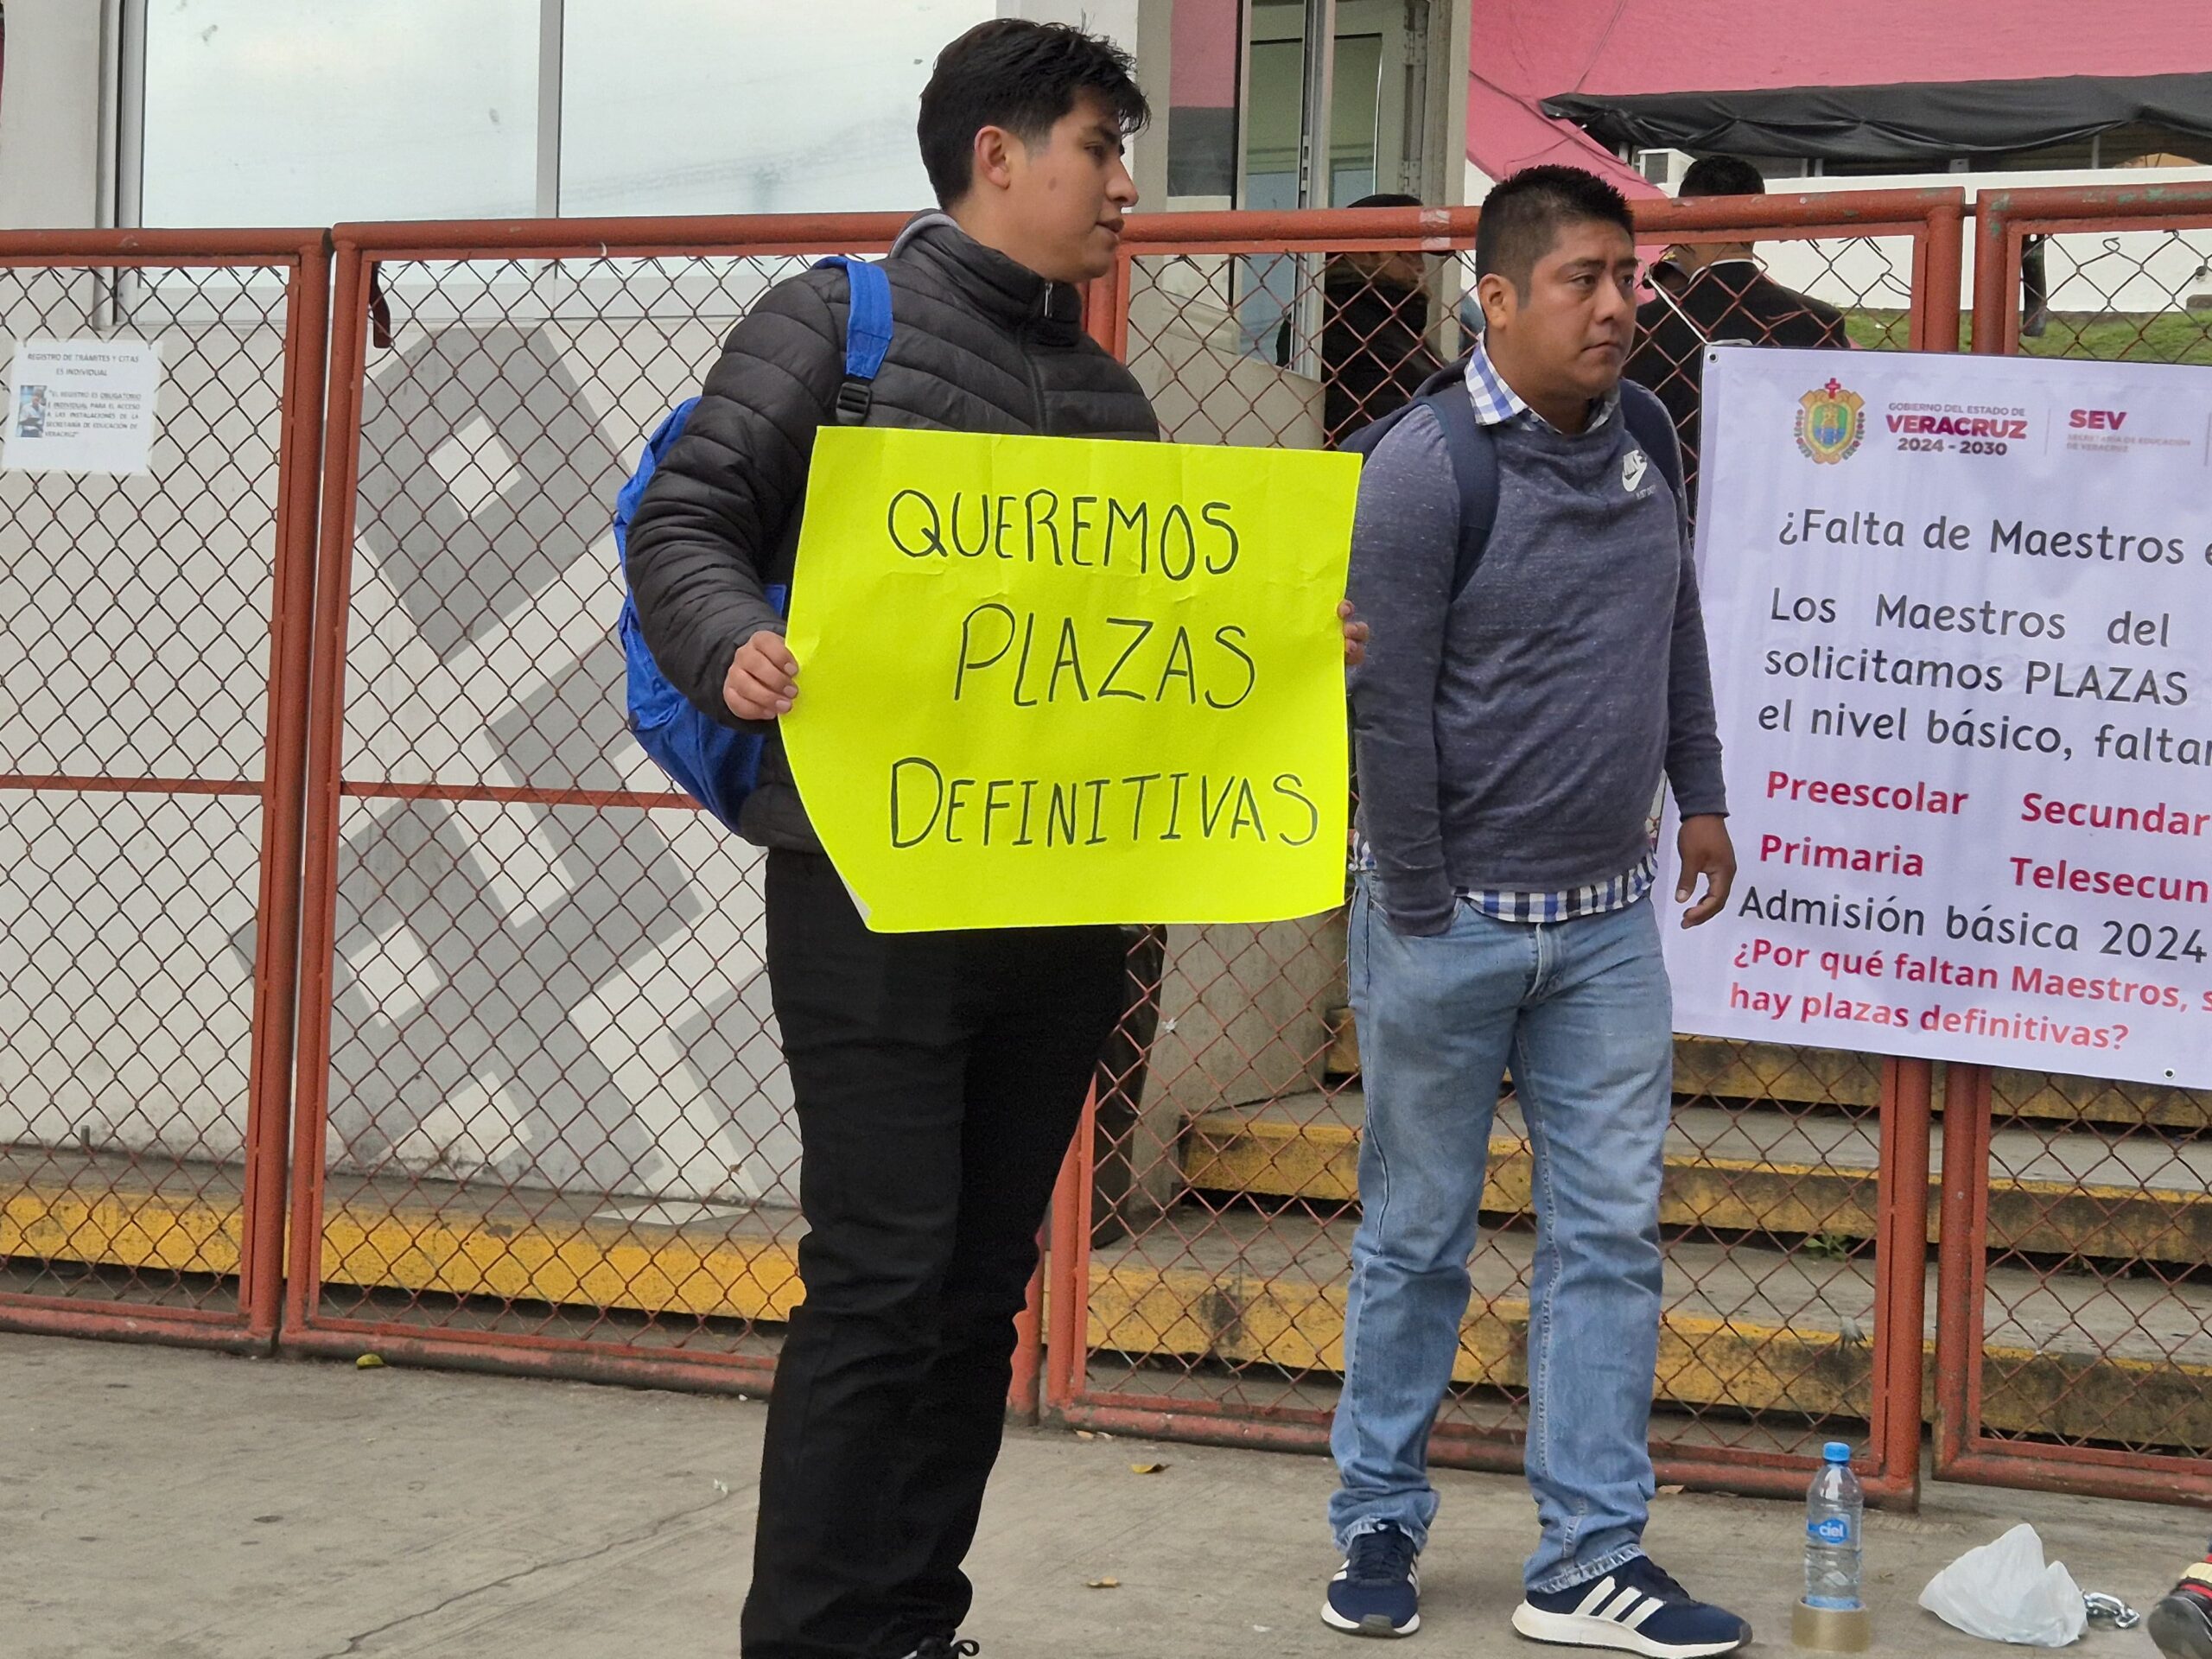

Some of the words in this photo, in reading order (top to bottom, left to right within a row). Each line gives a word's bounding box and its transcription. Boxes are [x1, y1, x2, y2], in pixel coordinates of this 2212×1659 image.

[66, 368, 108, 377] INDIVIDUAL
[118, 354, 139, 363] CITAS
[1885, 414, 2028, 440] VERACRUZ
[1888, 402, 1942, 412] GOBIERNO
[1944, 404, 1964, 413] DEL
[1967, 404, 2009, 416] ESTADO
[2011, 407, 2025, 416] DE
[2069, 408, 2127, 430] SEV
[1897, 437, 1944, 453] 2024
[1959, 440, 2007, 456] 2030
[2081, 443, 2129, 453] VERACRUZ
[888, 489, 1238, 581] QUEREMOS
[1779, 509, 1904, 546] ¿Falta
[1923, 516, 1970, 550] de
[1990, 519, 2183, 564] Maestros
[1771, 588, 1835, 623] Los
[1876, 594, 2065, 639] Maestros
[2107, 611, 2169, 647] del
[954, 602, 1255, 709] PLAZAS
[1764, 645, 2003, 691] solicitamos
[2025, 661, 2187, 705] PLAZAS
[1758, 699, 1792, 732] el
[1811, 702, 1906, 741] nivel
[1928, 709, 2071, 761] básico,
[891, 757, 1318, 849] DEFINITIVAS
[1767, 771, 1969, 815] Preescolar
[2021, 793, 2210, 836] Secundar
[1760, 835, 1923, 877] Primaria
[2010, 857, 2209, 903] Telesecun
[1738, 887, 1924, 936] Admisión
[1947, 905, 2077, 950] básica
[2100, 921, 2208, 963] 2024
[1734, 939, 1810, 968] ¿Por
[1821, 950, 1883, 980] qué
[1894, 953, 1998, 988] faltan
[2012, 966, 2187, 1012] Maestros,
[1731, 982, 1792, 1020] hay
[1801, 992, 1909, 1027] plazas
[1920, 1004, 2128, 1049] definitivas?
[1819, 1522, 1844, 1537] ciel
